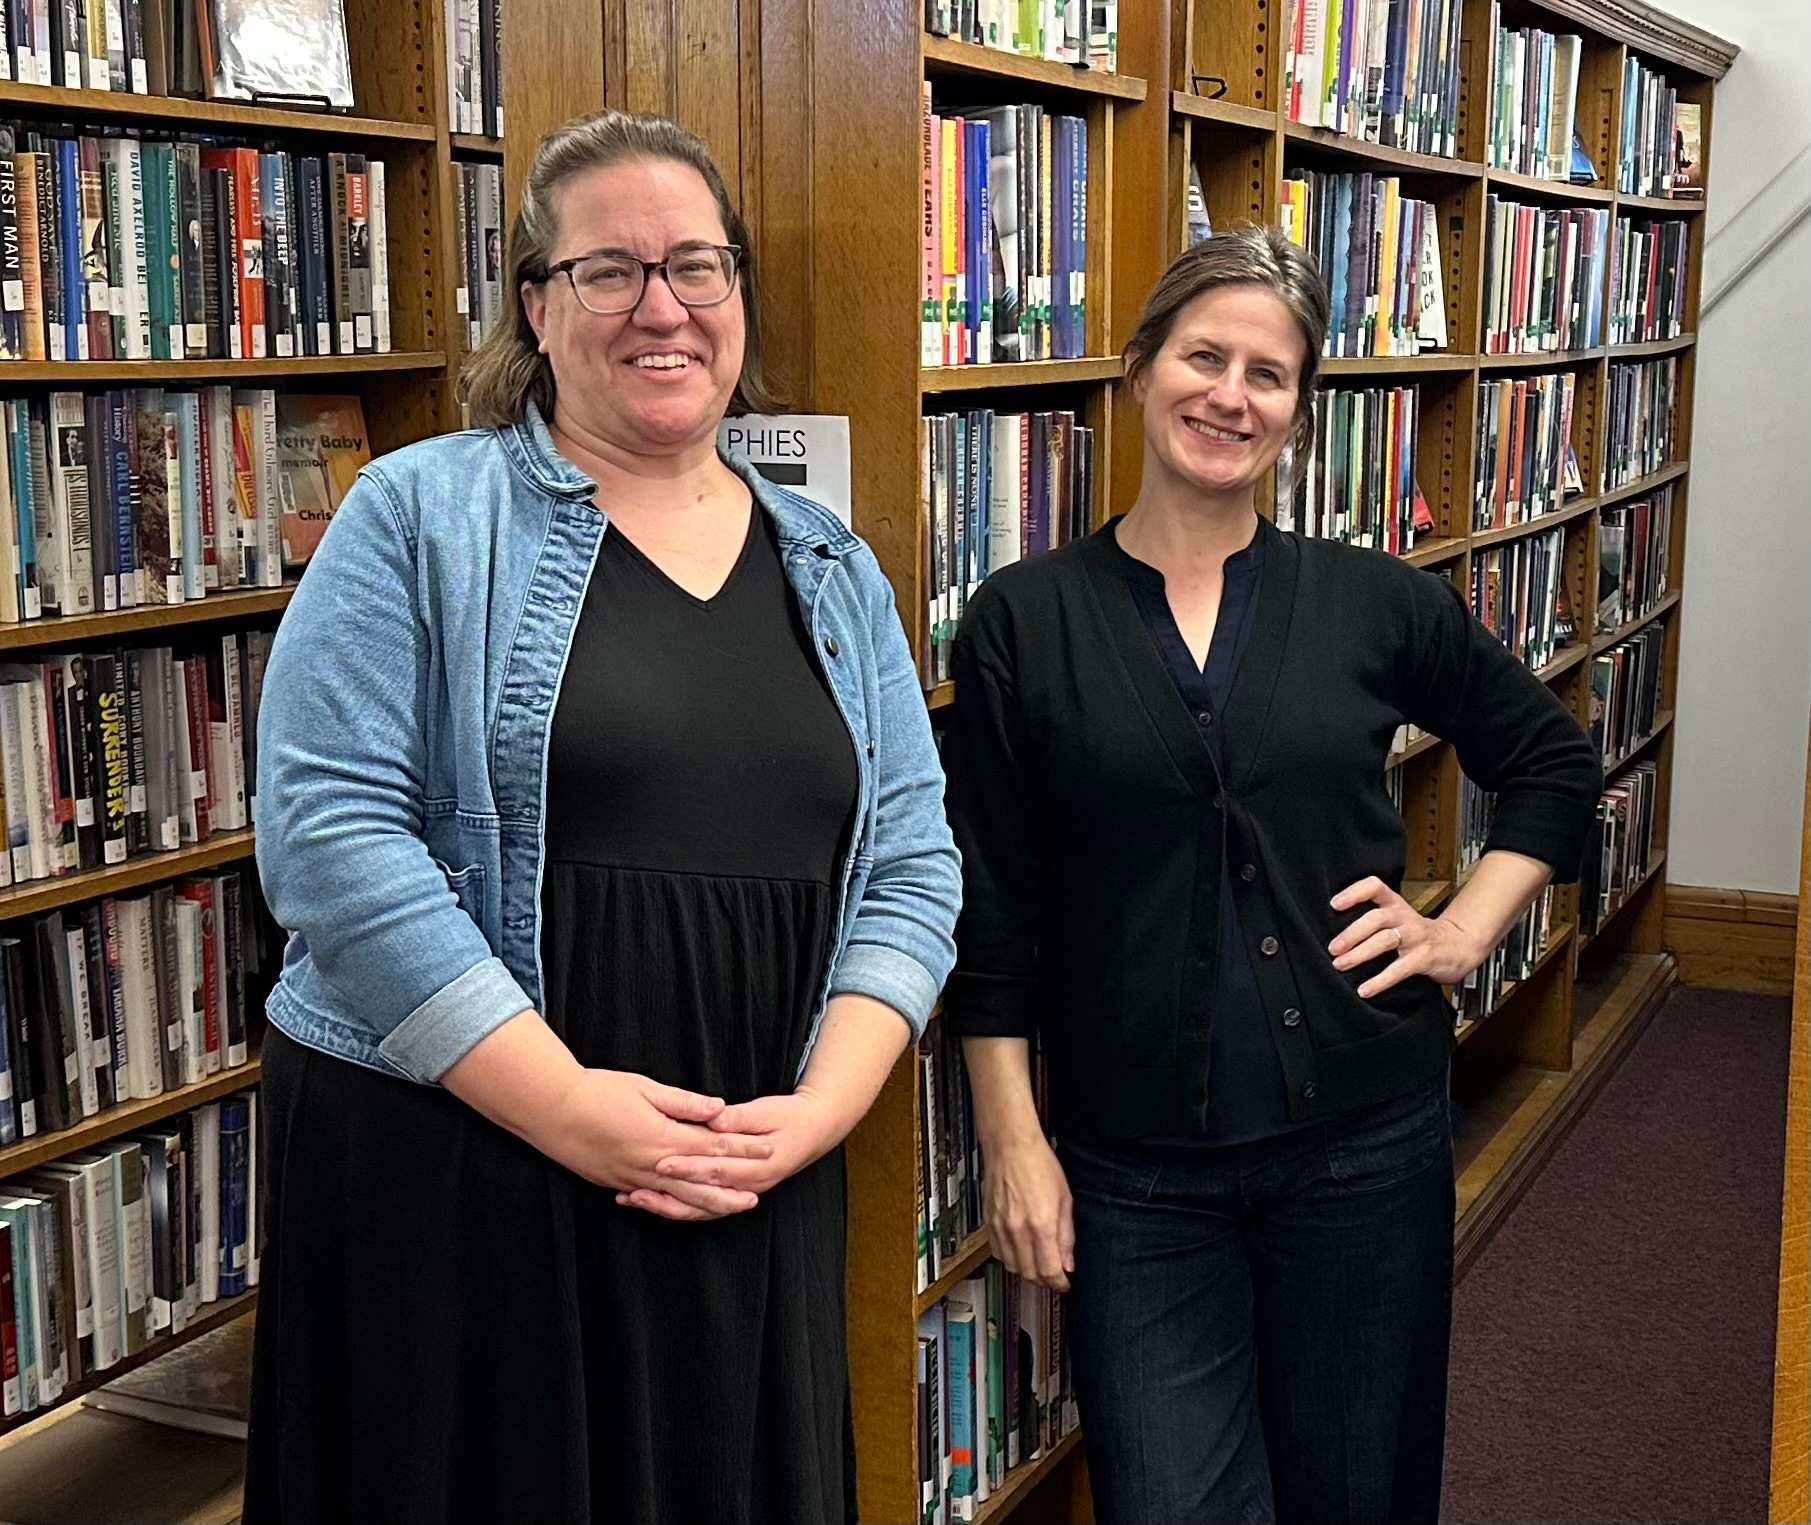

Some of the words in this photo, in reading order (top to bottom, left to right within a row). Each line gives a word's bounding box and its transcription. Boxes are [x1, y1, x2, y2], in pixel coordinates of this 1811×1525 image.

[37, 159, 47, 214] BENEDICT
[129, 151, 142, 191] DAVID
[167, 160, 175, 176] THE
[0, 160, 17, 217] FIRST
[168, 179, 176, 222] HOLLOW
[273, 177, 286, 206] INTO
[309, 178, 318, 208] AFTER
[336, 173, 346, 216] KNOCK
[351, 176, 363, 215] BARKLEY
[40, 216, 49, 263] ARNOLD
[132, 197, 146, 258] AXELROD
[229, 218, 237, 237] AND
[275, 209, 287, 231] THE
[311, 209, 320, 255] ANOTHER
[3, 226, 19, 268] MAN
[276, 234, 289, 265] DEEP
[137, 264, 150, 327] BEER
[263, 396, 272, 411] The
[112, 407, 122, 443] History
[277, 435, 315, 452] retty
[320, 434, 362, 451] Baby
[727, 428, 806, 457] PHIES
[116, 451, 130, 491] CARL
[265, 447, 277, 494] Gilmore
[282, 457, 329, 468] memoir
[267, 496, 279, 520] Girl
[299, 510, 333, 521] Chris
[118, 496, 133, 573] BERNSTEIN
[114, 662, 126, 705] UNITED
[121, 751, 130, 788] BOOK
[130, 690, 143, 733] ANTHONY
[98, 692, 125, 818] SURRENDER
[139, 917, 150, 972] MATTERS
[78, 959, 86, 982] WE
[116, 1032, 128, 1067] BURK
